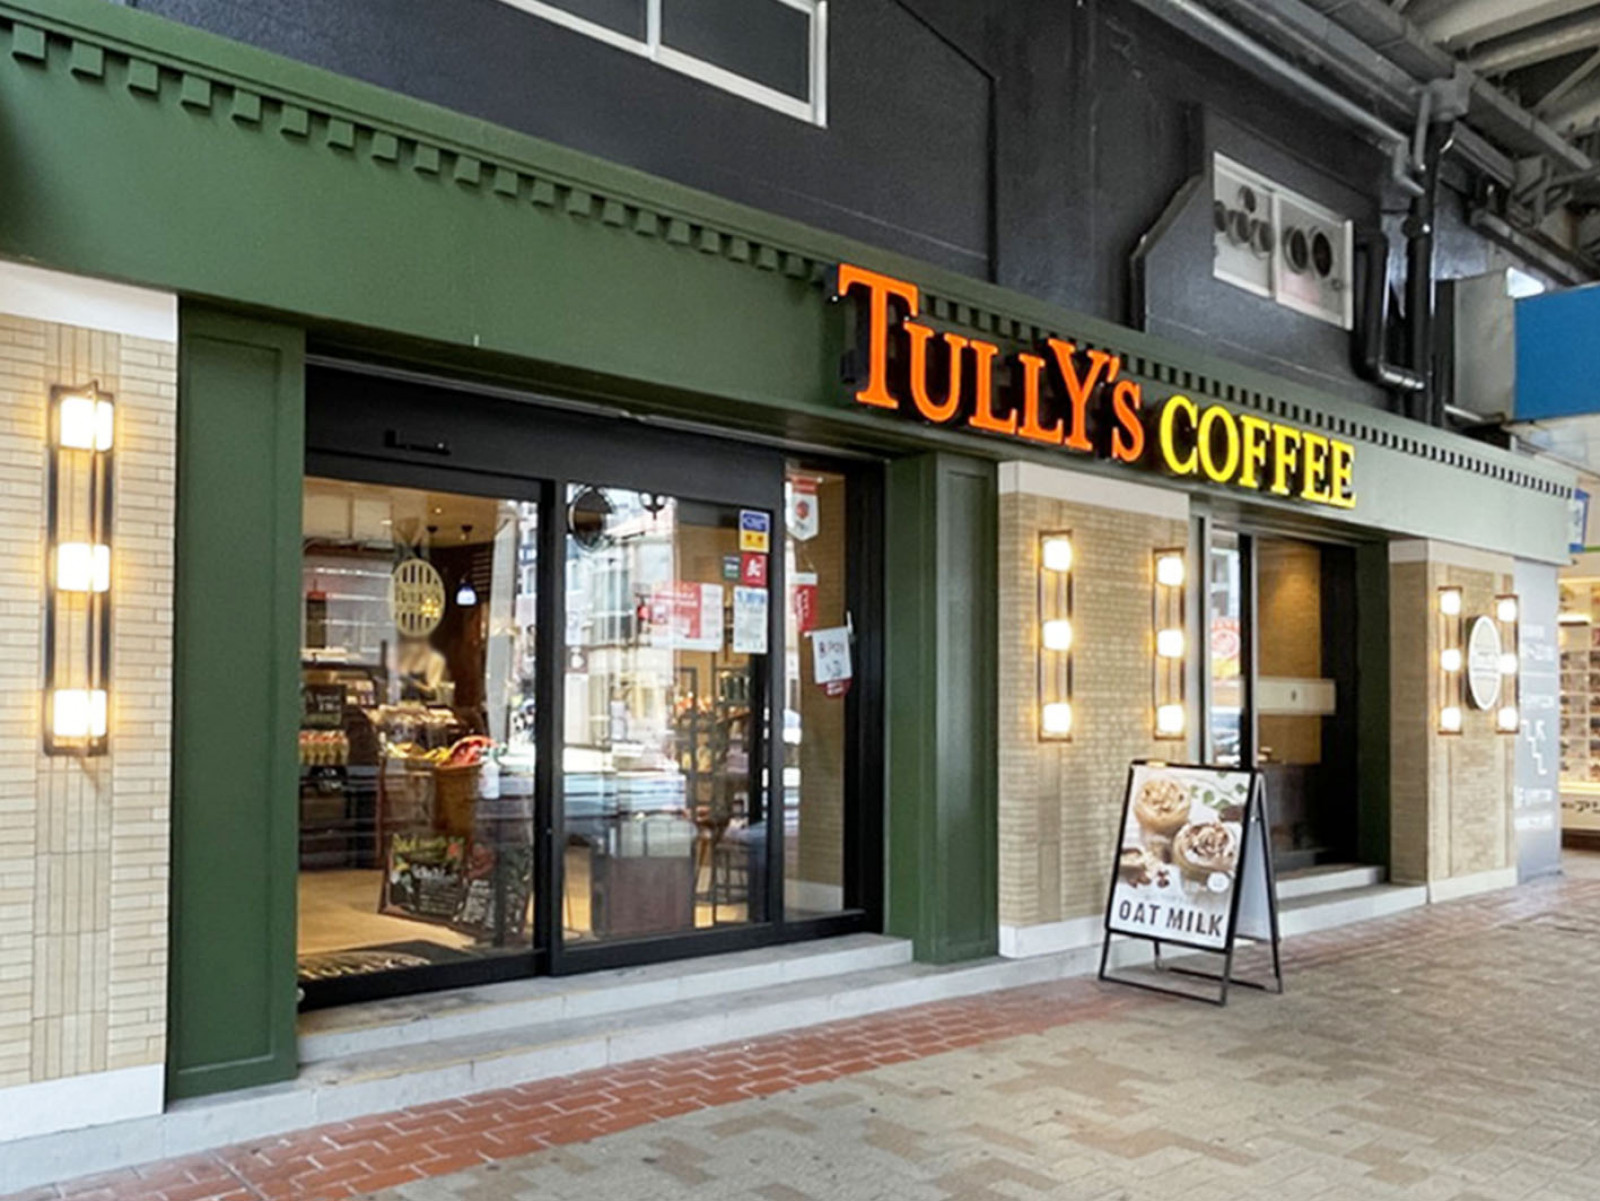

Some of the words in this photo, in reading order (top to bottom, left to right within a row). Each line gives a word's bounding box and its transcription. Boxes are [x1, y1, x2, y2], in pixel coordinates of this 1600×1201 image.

[838, 263, 1144, 462] TULLY'S
[1159, 394, 1355, 507] COFFEE
[1119, 900, 1161, 925] OAT
[1166, 907, 1223, 937] MILK
